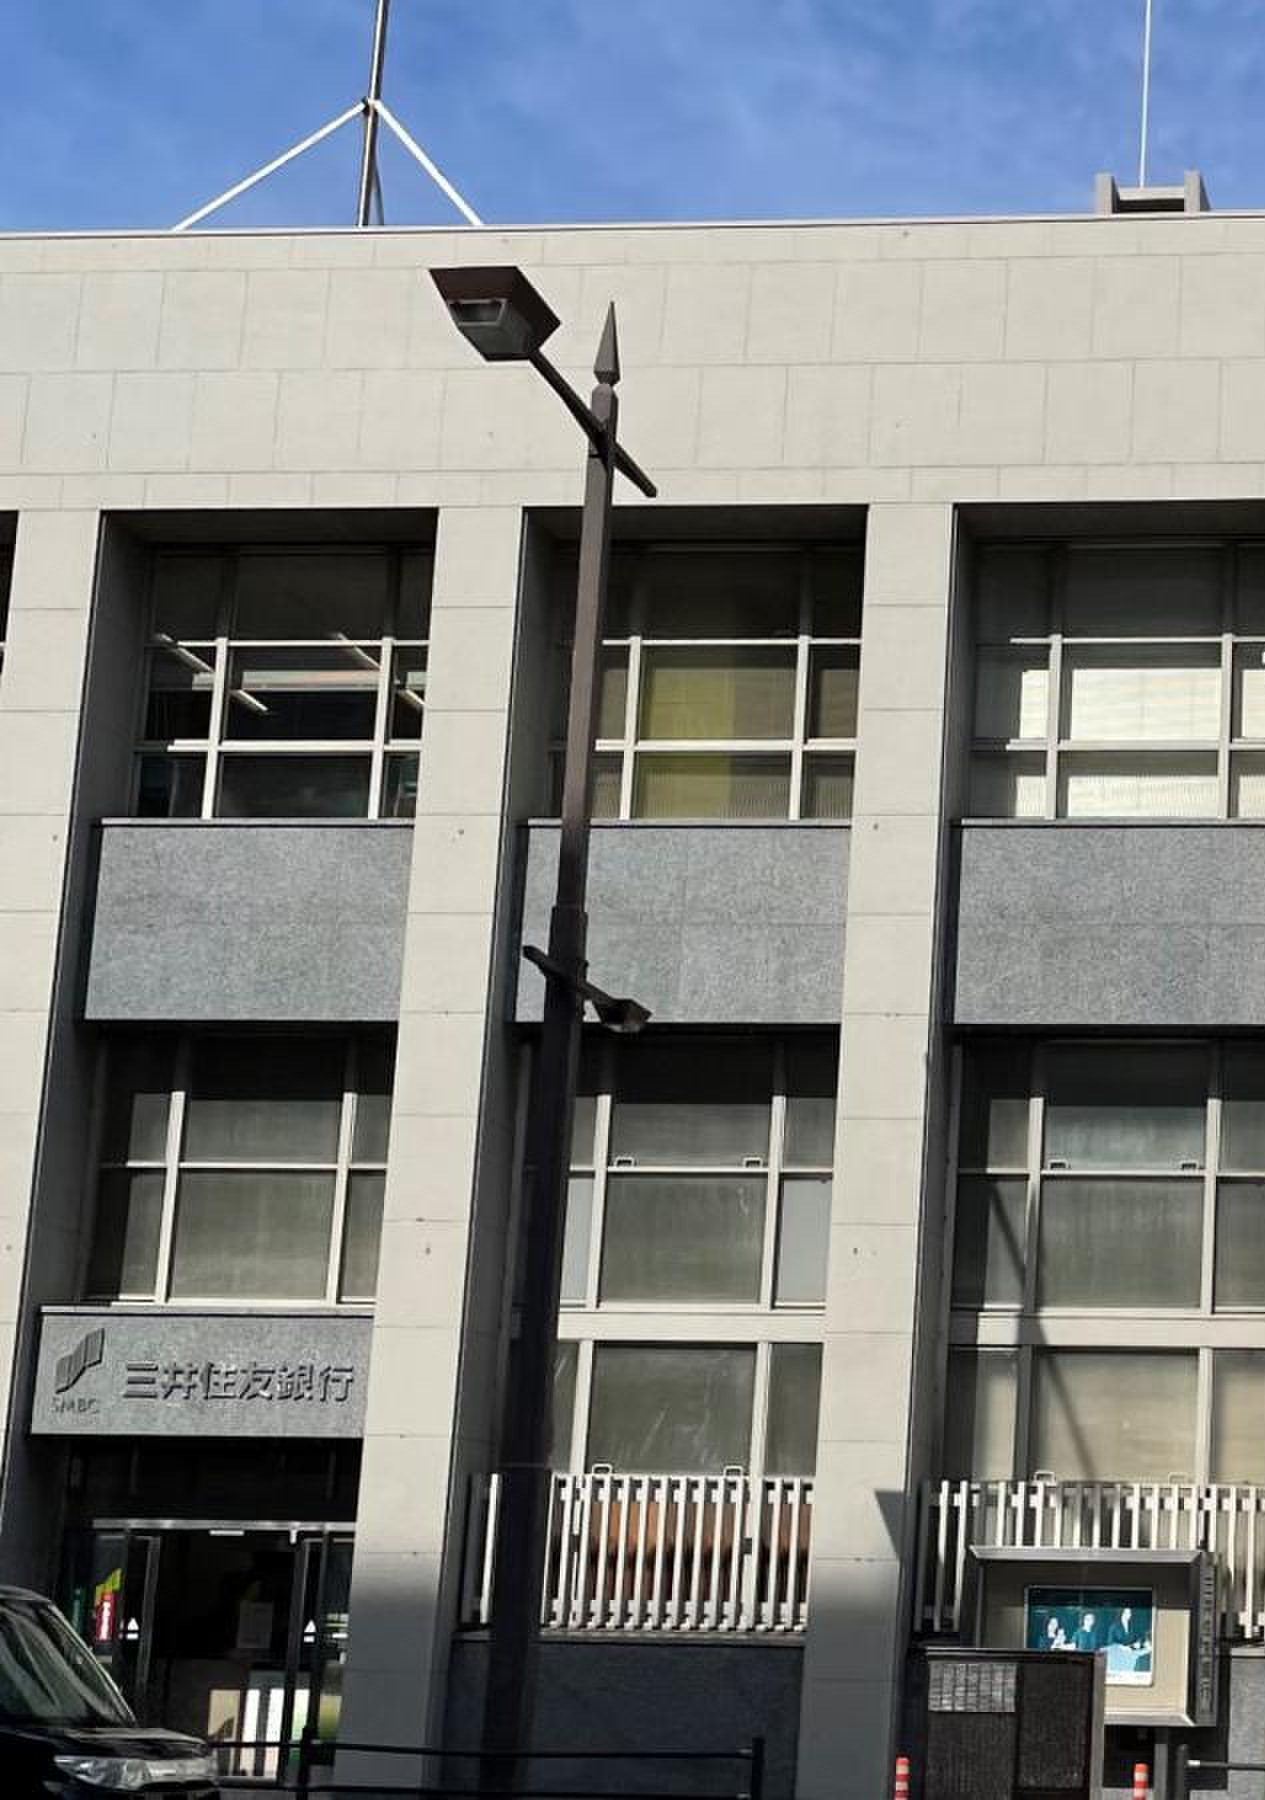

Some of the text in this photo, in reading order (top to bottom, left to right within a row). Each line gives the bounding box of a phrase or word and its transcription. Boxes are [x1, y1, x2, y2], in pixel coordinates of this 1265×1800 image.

[124, 1361, 355, 1402] 三井住友銀行
